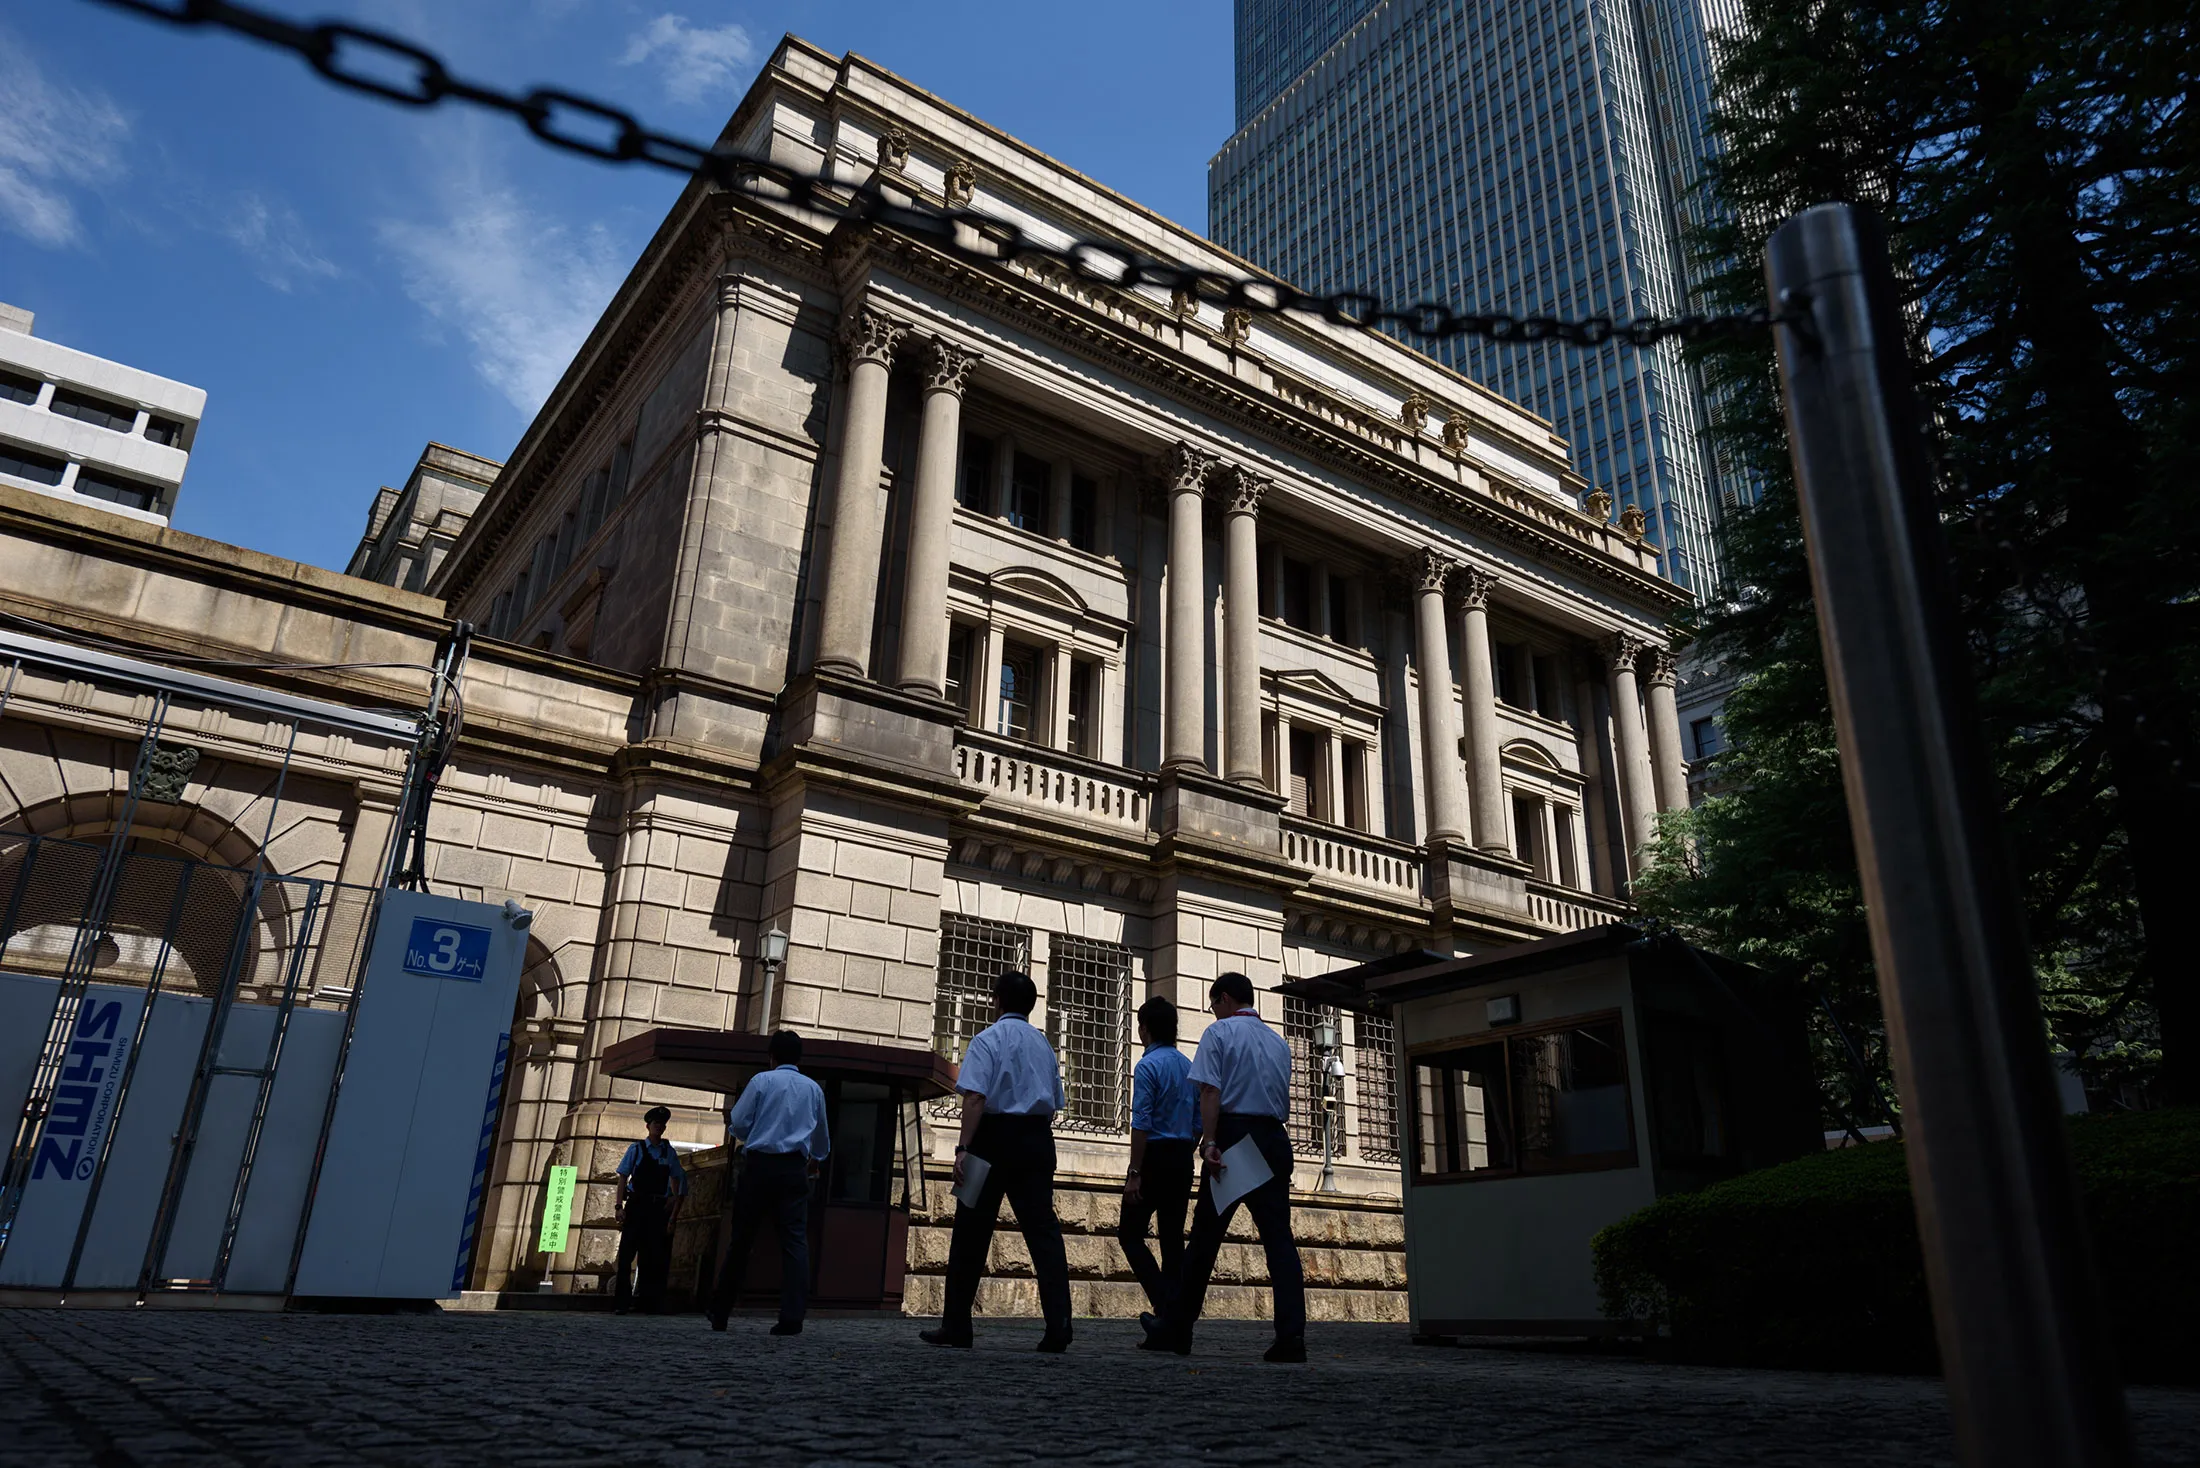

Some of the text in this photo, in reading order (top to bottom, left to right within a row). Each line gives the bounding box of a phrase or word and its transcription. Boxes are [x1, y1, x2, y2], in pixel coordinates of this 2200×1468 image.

[406, 928, 481, 976] No. 3 ゲート
[86, 1036, 128, 1155] SHIMIZU CORPORATION
